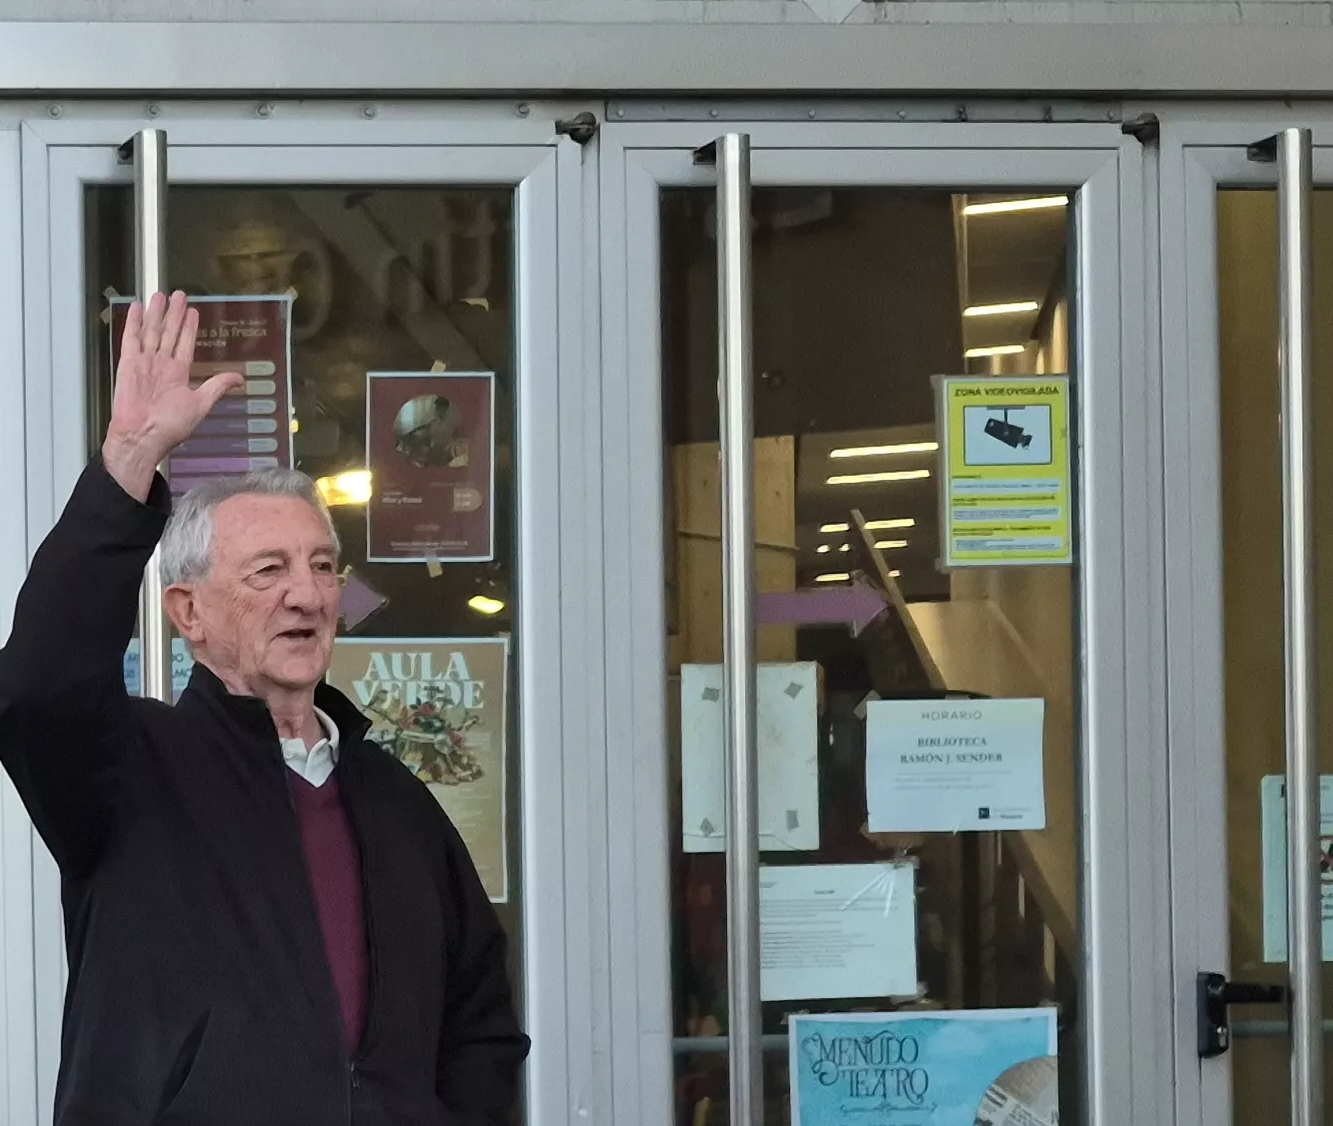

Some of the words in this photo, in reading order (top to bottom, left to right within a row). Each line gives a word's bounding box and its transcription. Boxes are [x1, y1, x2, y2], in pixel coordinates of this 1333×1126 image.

[954, 386, 982, 397] ZONA
[364, 651, 470, 681] AULA
[921, 710, 982, 721] HORARIO
[917, 737, 987, 747] BIBLIOTECA
[900, 751, 943, 764] RAMÓN
[956, 752, 1003, 763] SENDER
[803, 1030, 919, 1074] MENUDO
[839, 1067, 929, 1105] TEATRO
